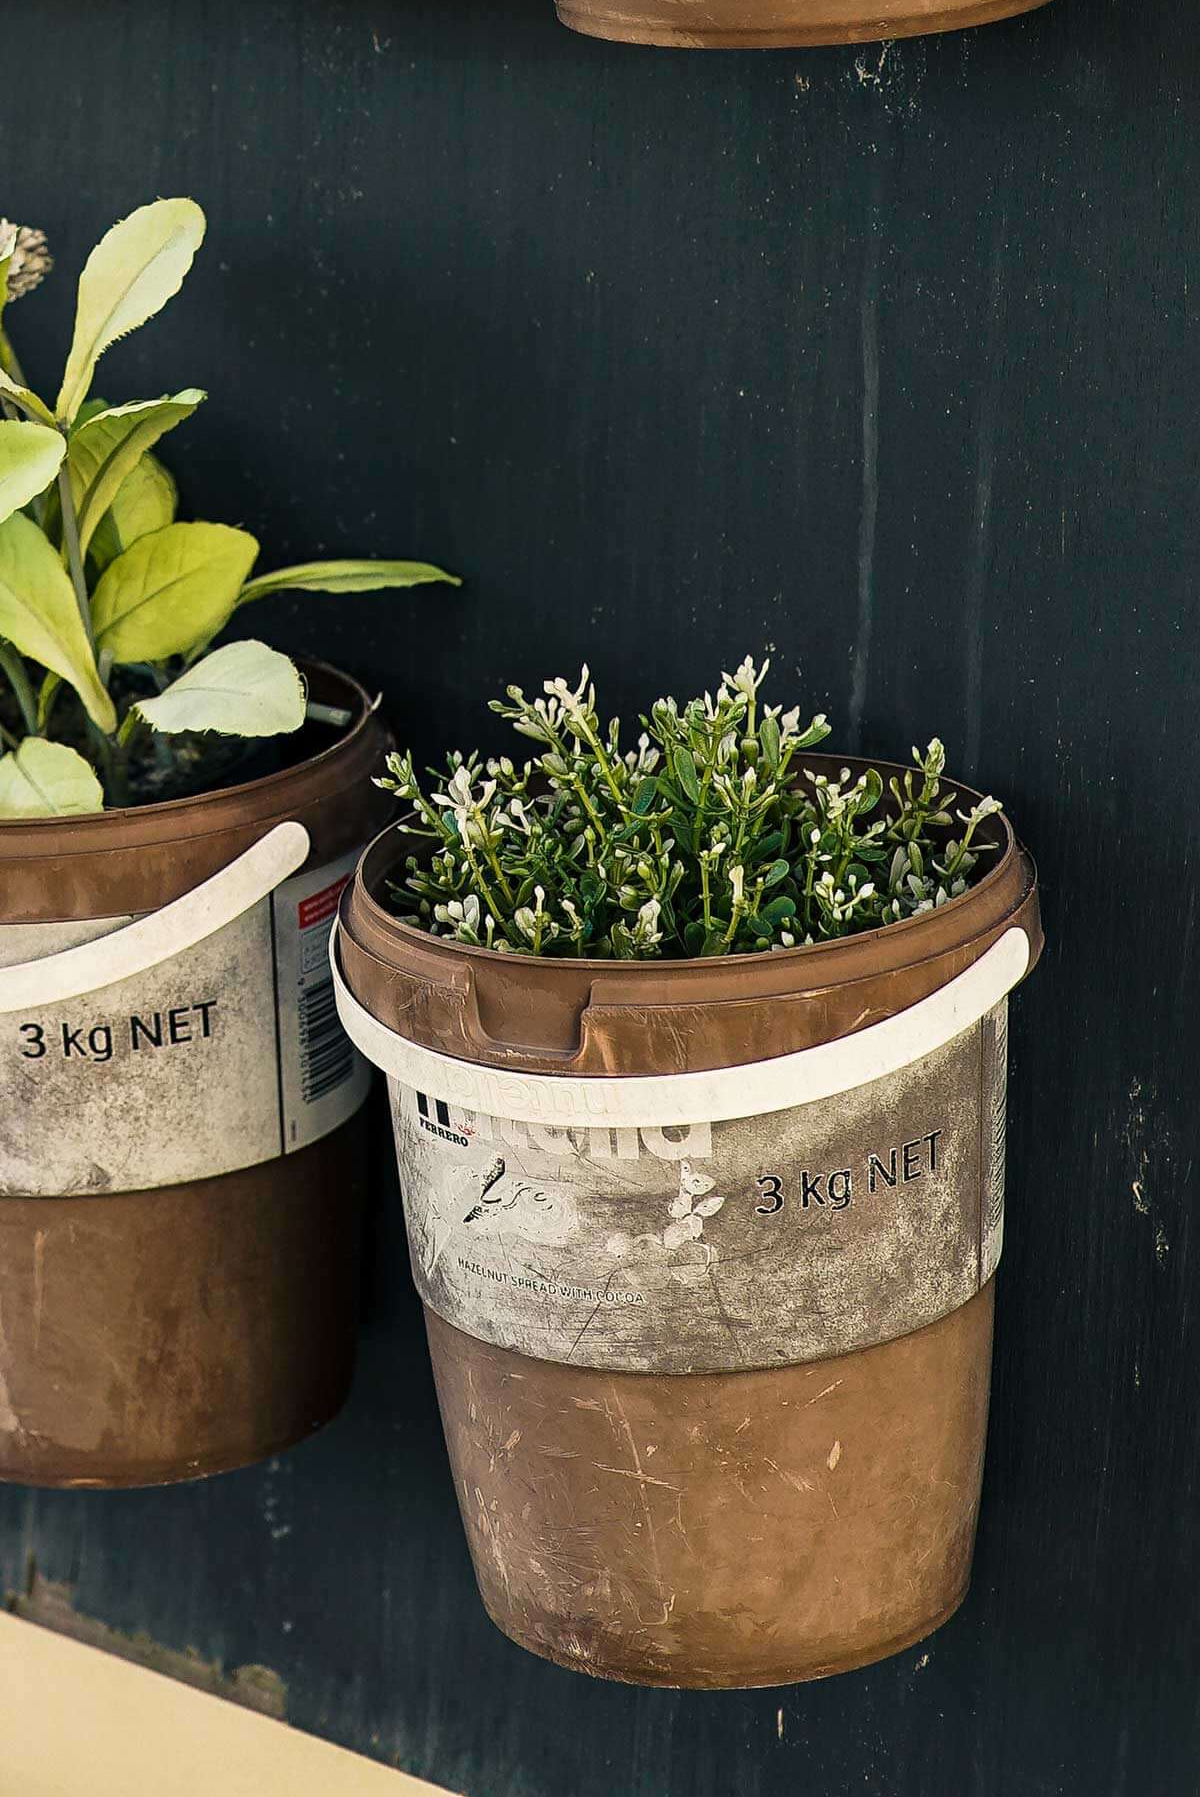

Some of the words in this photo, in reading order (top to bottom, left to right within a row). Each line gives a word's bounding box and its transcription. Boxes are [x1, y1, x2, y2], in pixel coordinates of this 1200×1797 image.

[18, 1022, 47, 1059] 3
[61, 1022, 113, 1063] kg
[129, 999, 218, 1051] NET
[418, 1115, 470, 1148] FERRERO
[754, 1174, 785, 1215] 3
[800, 1169, 852, 1212] kg
[867, 1128, 943, 1194] NET
[457, 1257, 509, 1284] HAZELNUT
[510, 1275, 558, 1296] SPREAD
[558, 1285, 594, 1302] WITH
